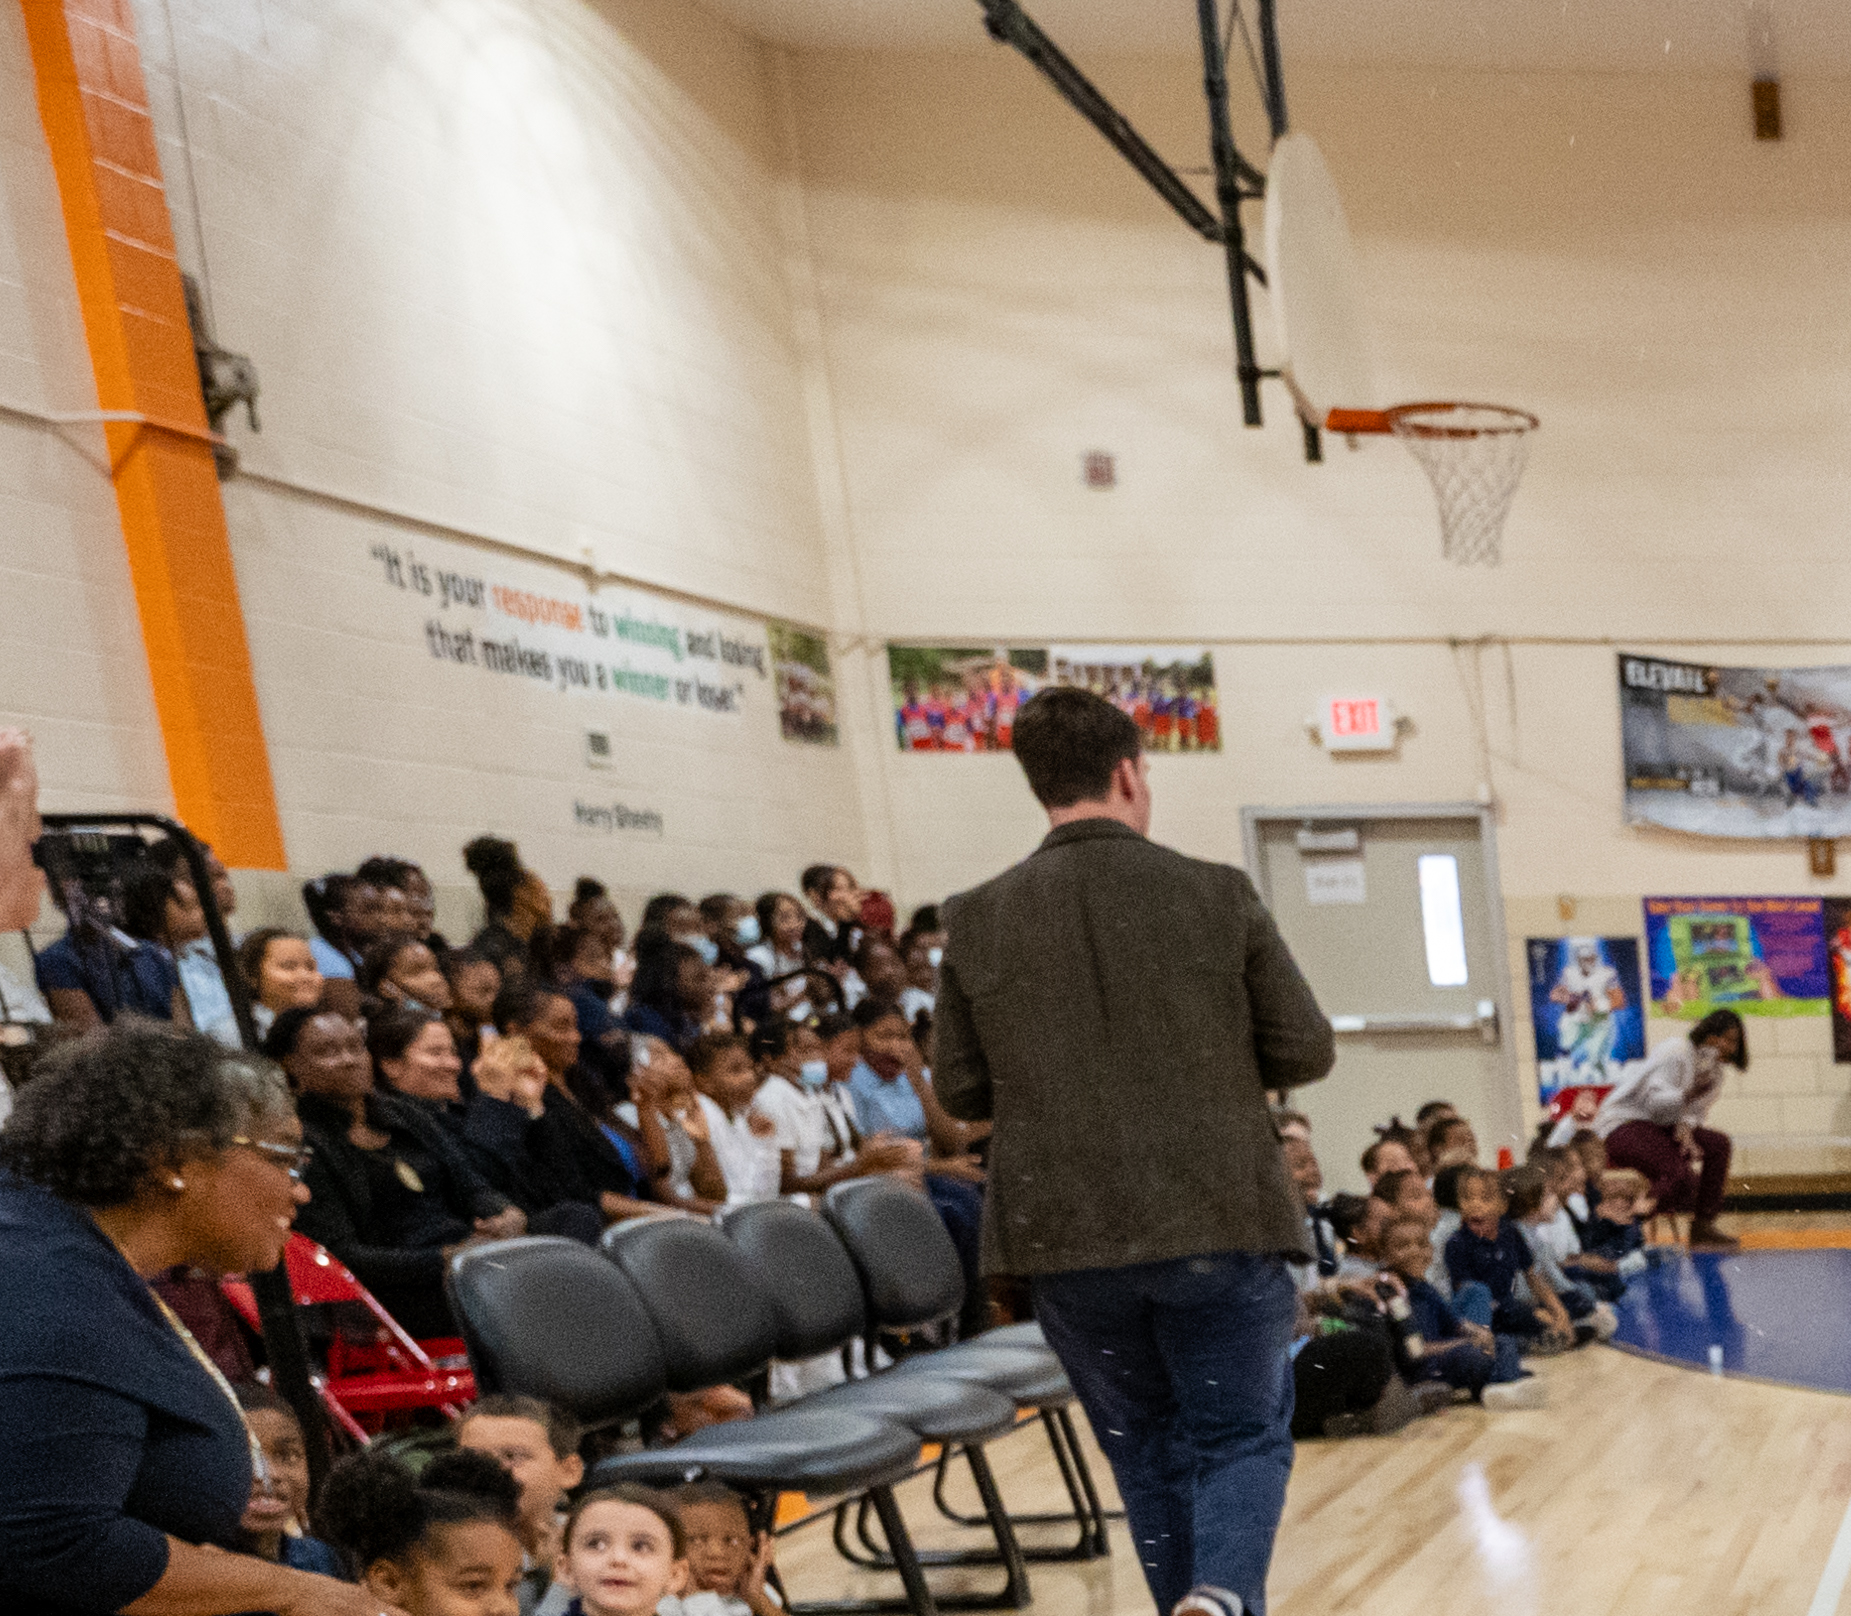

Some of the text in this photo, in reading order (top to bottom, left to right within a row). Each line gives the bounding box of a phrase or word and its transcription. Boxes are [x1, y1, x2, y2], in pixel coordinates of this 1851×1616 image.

[439, 571, 486, 610] your
[492, 584, 585, 633] response
[589, 604, 609, 638] to
[614, 607, 684, 662] winning
[686, 628, 718, 660] and
[426, 619, 478, 665] that
[482, 638, 553, 682] makes
[557, 656, 591, 692] you
[596, 660, 608, 691] a
[613, 661, 671, 700] winner
[675, 678, 692, 705] or
[1330, 699, 1379, 736] EXIT
